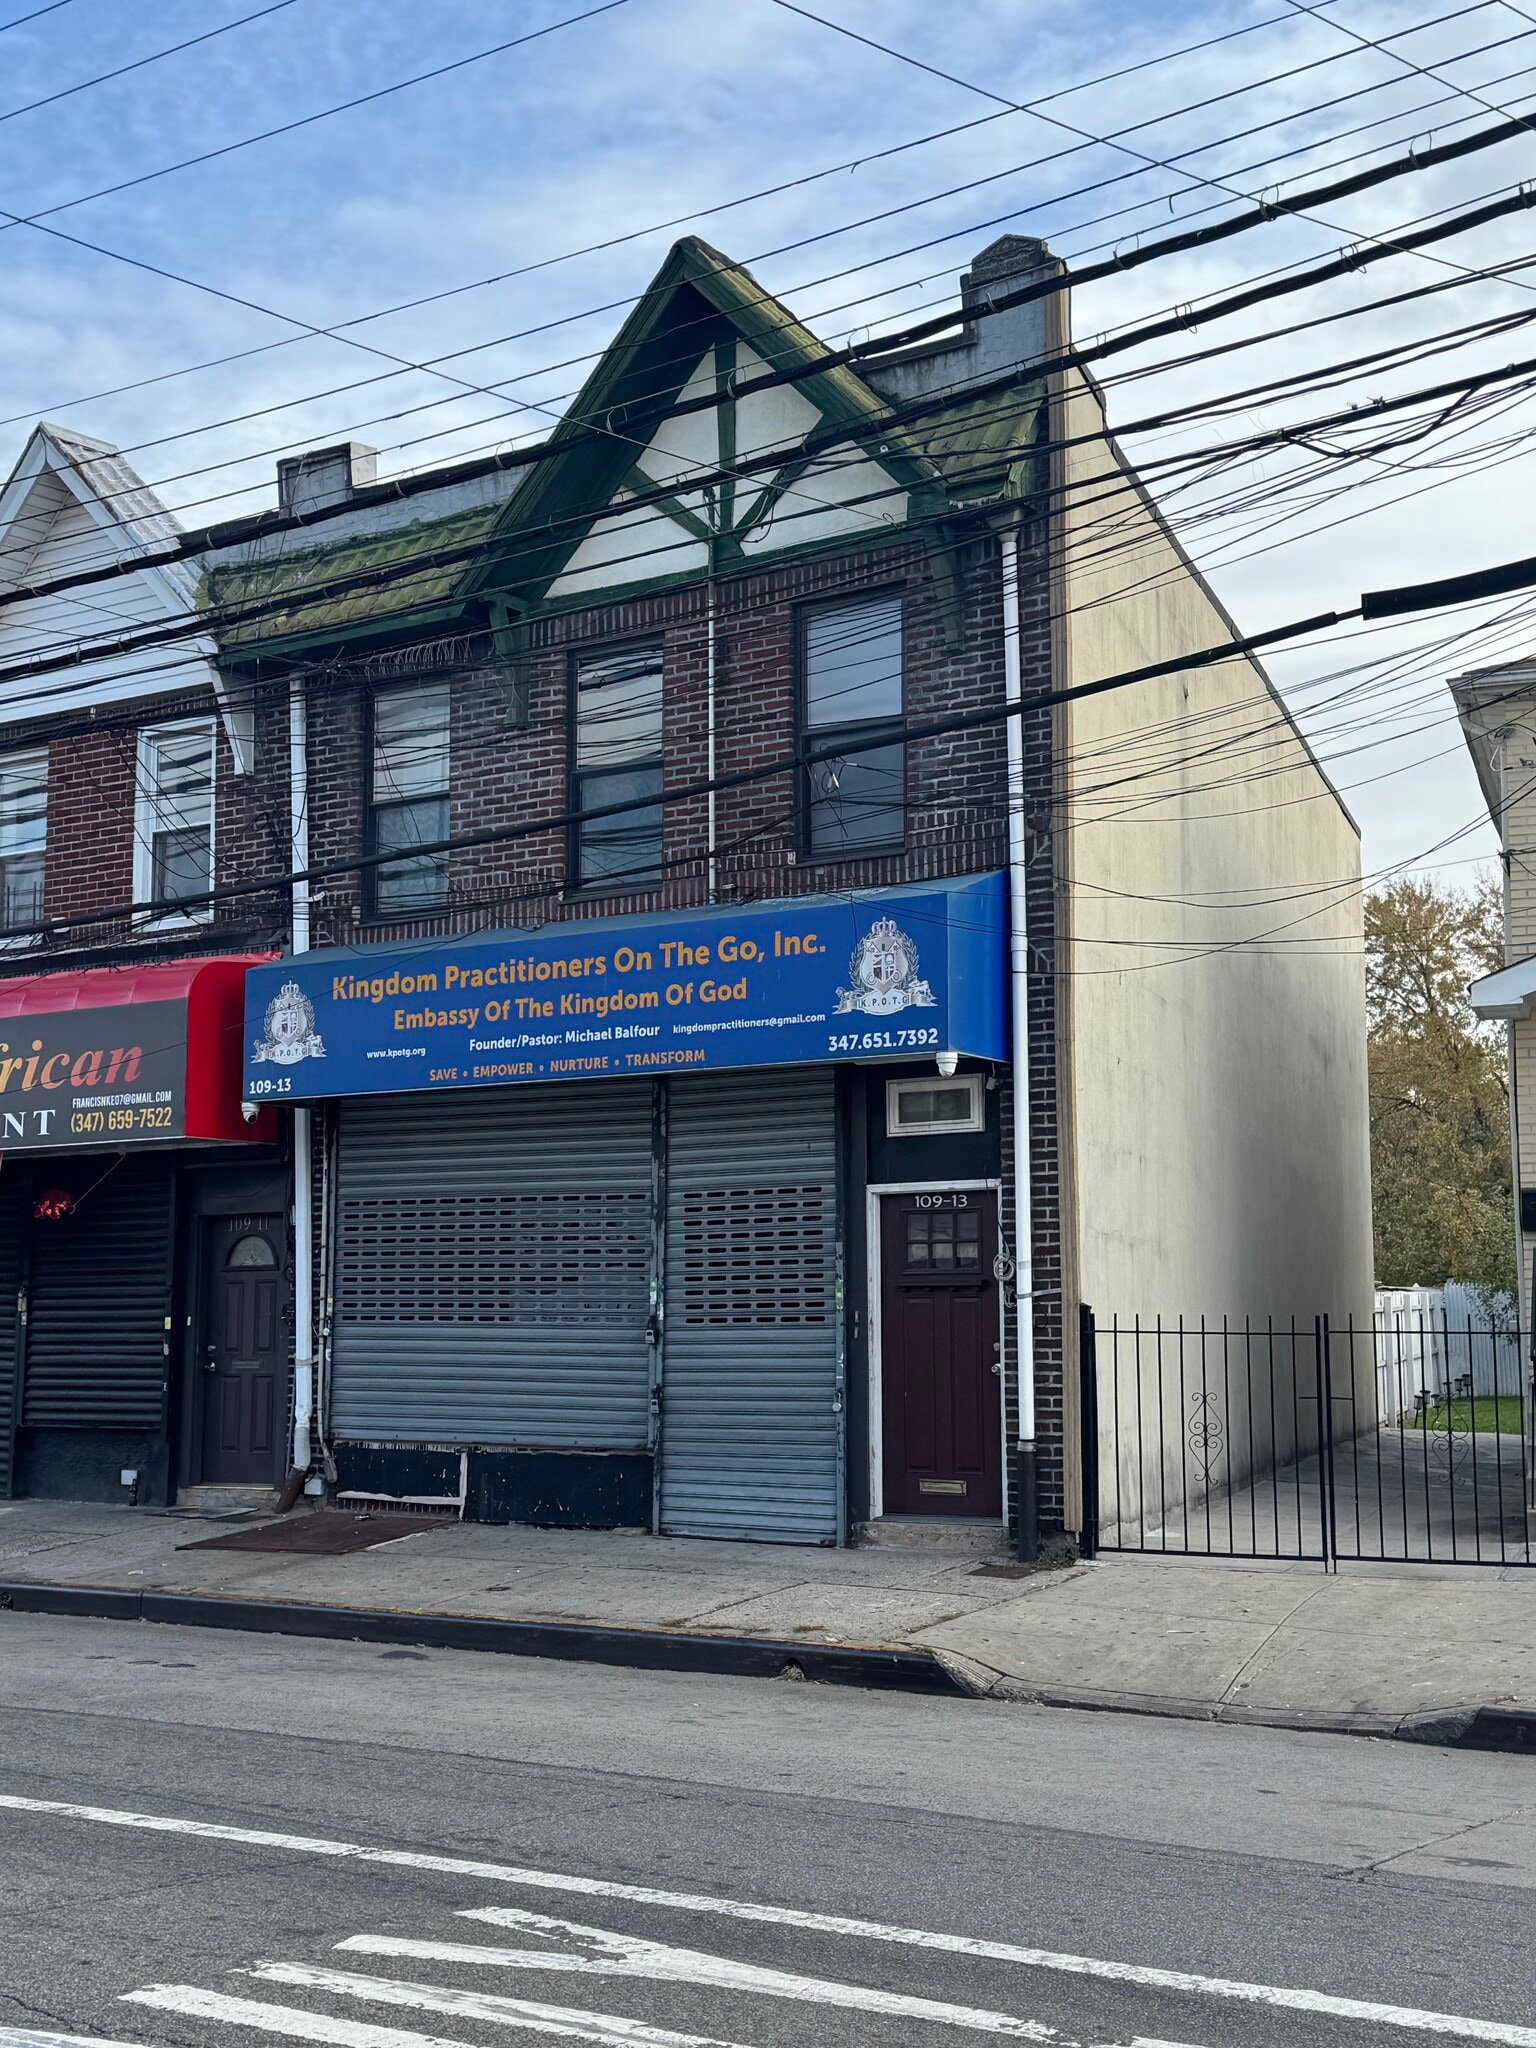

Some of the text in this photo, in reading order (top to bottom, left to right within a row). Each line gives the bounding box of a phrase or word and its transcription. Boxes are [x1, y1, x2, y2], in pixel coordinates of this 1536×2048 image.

[332, 931, 826, 1003] Kingdom Practitioners On The Go, Inc.
[394, 977, 747, 1030] Embassy Of The Kingdom Of God
[672, 1013, 826, 1035] kingdompractitioners@gmail.com
[469, 1024, 660, 1052] Founder/Pastor: Michael Balfour
[828, 1028, 939, 1052] 347.651.7392
[0, 1039, 142, 1093] rican
[366, 1047, 427, 1060] www.kpotg.org
[429, 1049, 706, 1082] SAVE EMPOWER NURTURE TRANSFORM
[249, 1078, 292, 1095] 109-13
[70, 1107, 172, 1133] (347) 659-7522
[914, 1194, 968, 1208] 109-13
